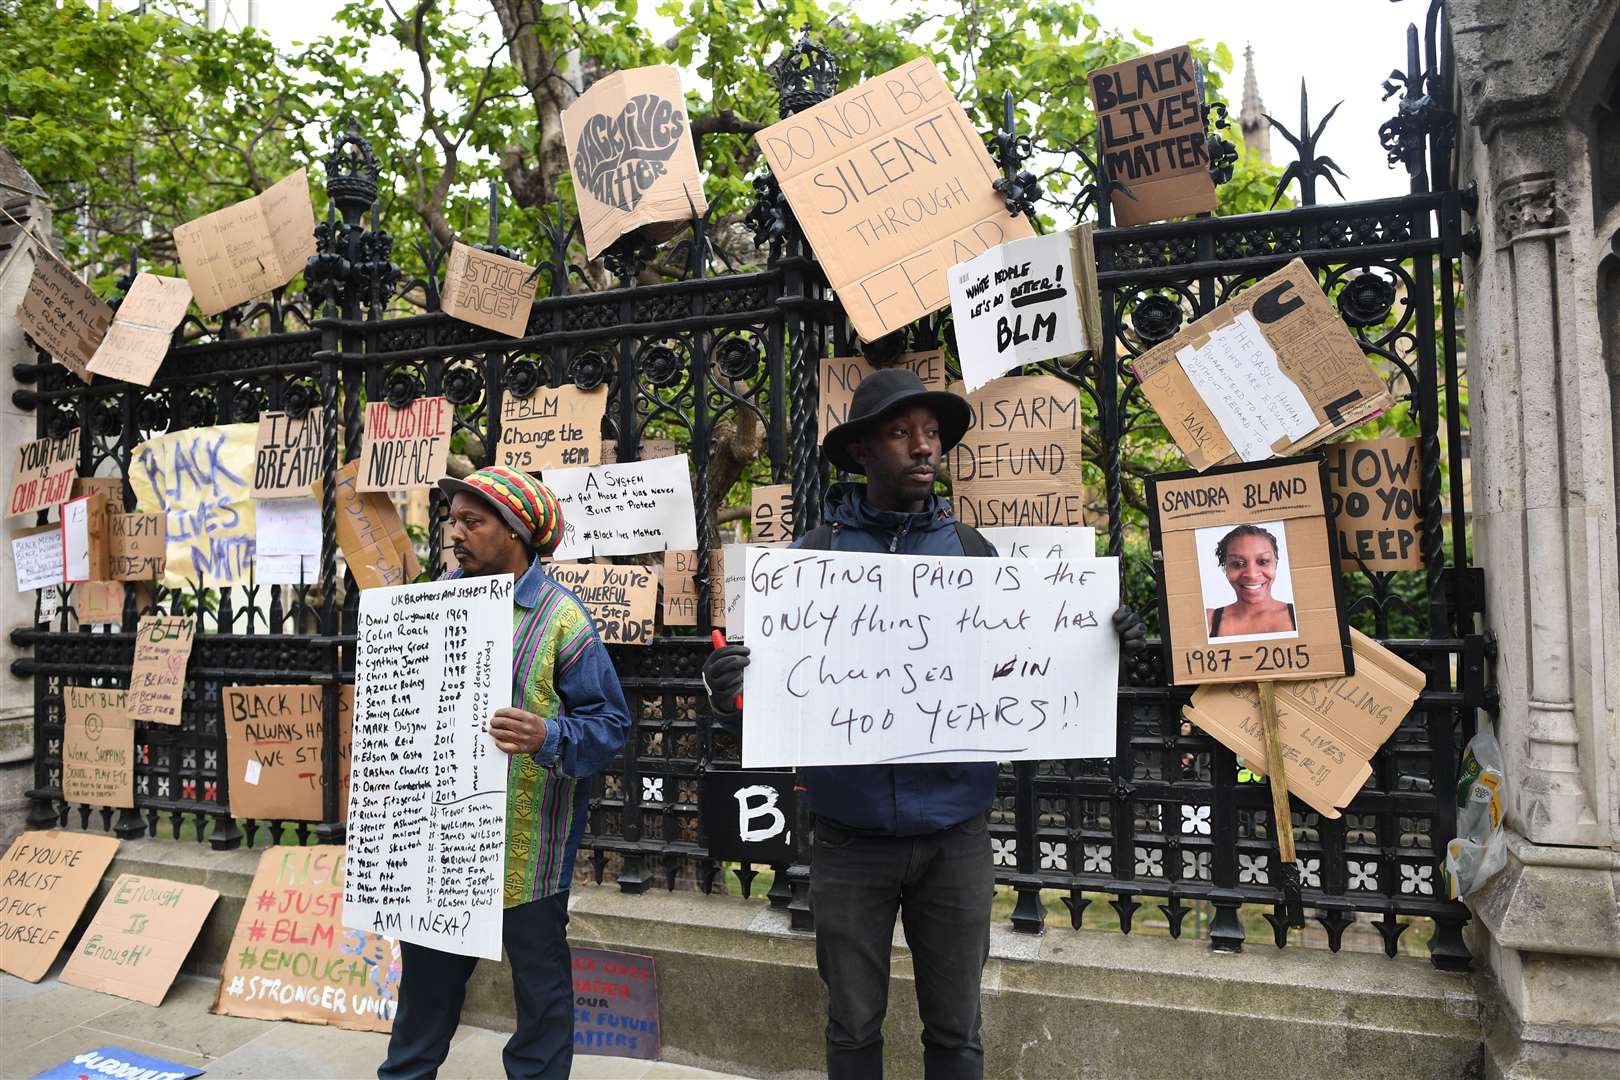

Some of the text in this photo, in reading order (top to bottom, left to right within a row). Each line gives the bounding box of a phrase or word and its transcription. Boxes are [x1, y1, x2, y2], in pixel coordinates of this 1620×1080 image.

[1093, 52, 1193, 112] BLACK
[767, 63, 943, 171] DO NOT BE
[1102, 91, 1200, 147] LIVES
[814, 114, 952, 215] SILENT
[1106, 133, 1209, 180] MATTER
[848, 176, 970, 246] THROUGH
[993, 294, 1004, 308] DO
[997, 312, 1057, 353] BLM
[369, 398, 447, 440] NO JUSTICE
[504, 395, 559, 421] #BLM
[503, 423, 584, 449] Change the
[20, 429, 80, 474] YOUR FIGHT
[368, 437, 441, 487] NO PEACE
[505, 450, 532, 467] sys
[956, 442, 1065, 482] DEFUND
[40, 466, 49, 479] IS
[585, 472, 600, 492] A
[1329, 448, 1416, 488] HOW
[11, 468, 74, 514] OUR FIGHT
[1161, 477, 1307, 513] SANDRA BLAND
[959, 492, 1081, 528] DISMANTLE
[602, 567, 649, 589] You're
[675, 552, 725, 574] BLCK
[751, 551, 883, 596] GETTING
[911, 561, 974, 598] PAID
[994, 566, 1021, 592] IS
[446, 608, 469, 622] 1969
[602, 605, 631, 619] Step
[761, 600, 1036, 651] ONLY thing that
[440, 681, 466, 692] 2005
[230, 692, 293, 722] BLACK
[437, 703, 456, 714] 2011
[471, 692, 480, 728] 1000
[85, 712, 104, 742] @
[245, 722, 303, 743] ALWAYS
[436, 717, 456, 731] 2011
[831, 705, 895, 746] 400
[255, 749, 286, 769] WE
[432, 749, 456, 761] 2017
[1299, 727, 1346, 766] LIVES
[10, 844, 30, 863] IF
[2, 868, 63, 892] RACIST
[7, 899, 48, 919] FUCK
[0, 920, 60, 946] OURSELF
[248, 918, 336, 949] #BLM
[238, 946, 368, 988] #ENOUGH
[576, 996, 609, 1009] OUR
